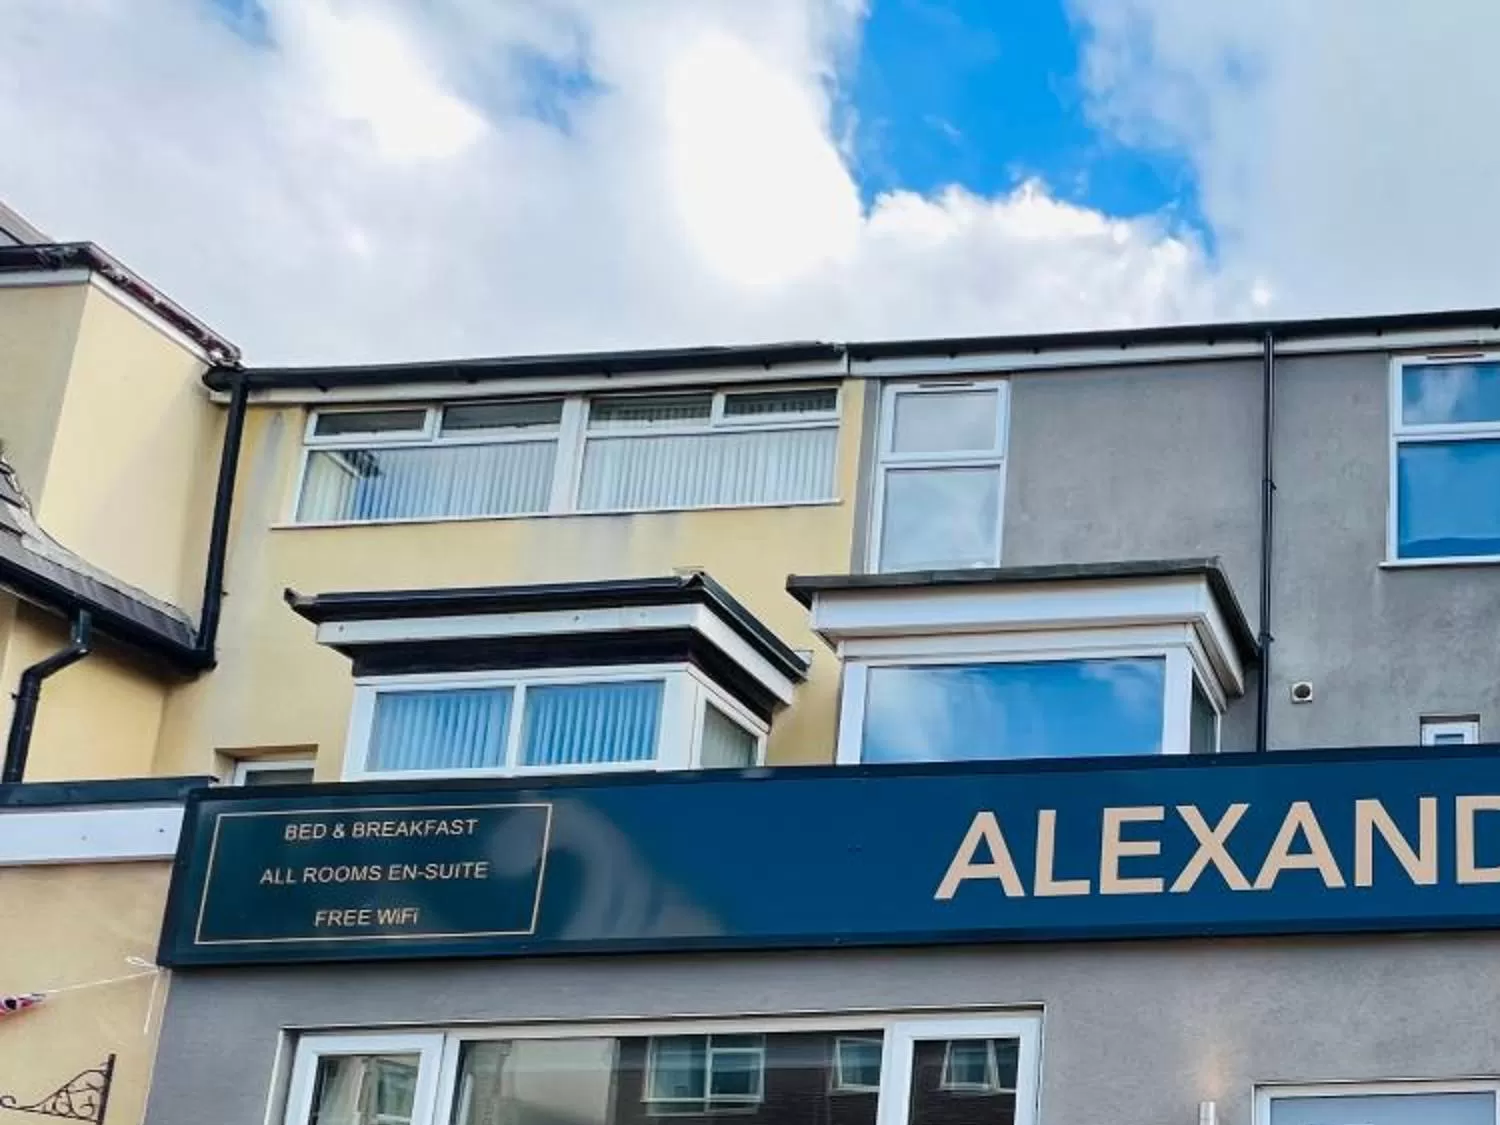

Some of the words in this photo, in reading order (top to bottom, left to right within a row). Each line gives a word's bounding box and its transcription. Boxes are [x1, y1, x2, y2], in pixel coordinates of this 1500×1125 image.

[284, 823, 328, 841] BED
[332, 820, 345, 839] &
[351, 818, 478, 839] BREAKFAST
[259, 868, 297, 886] ALL
[302, 864, 381, 883] ROOMS
[388, 861, 489, 881] EN-SUITE
[314, 908, 371, 928] FREE
[376, 907, 419, 926] WiFi
